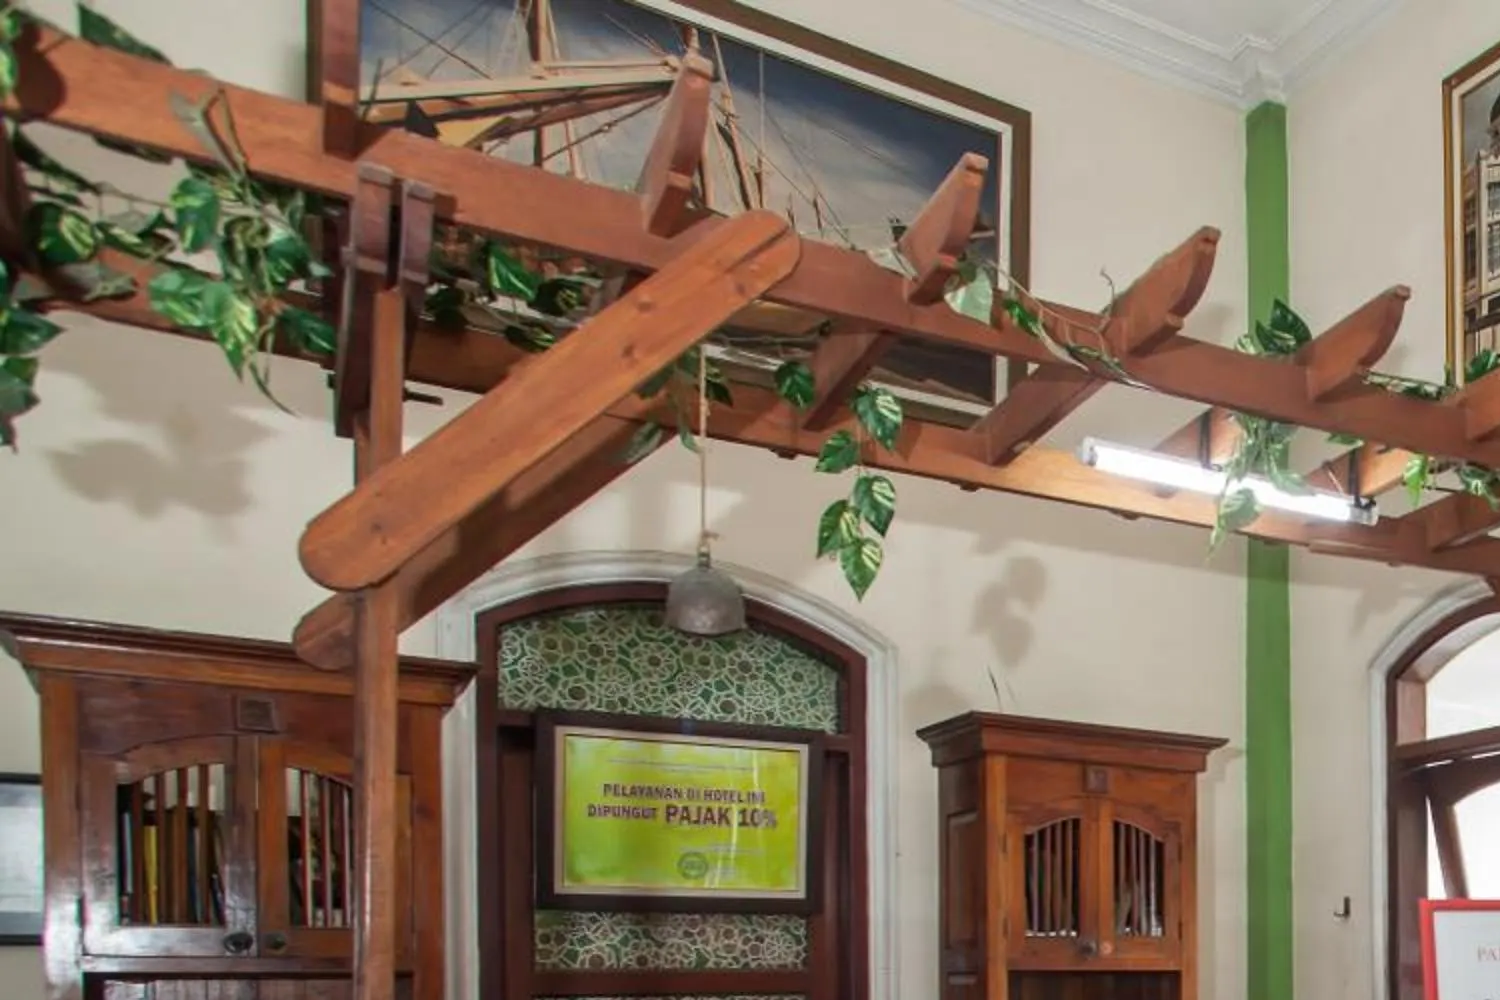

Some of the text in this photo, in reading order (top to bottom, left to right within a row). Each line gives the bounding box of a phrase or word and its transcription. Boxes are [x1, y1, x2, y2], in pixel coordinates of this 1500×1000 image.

[603, 783, 681, 800] PELAYANAN
[703, 789, 743, 804] HOTEL
[587, 803, 658, 819] DIPUNGUT
[665, 804, 732, 827] PAJAK
